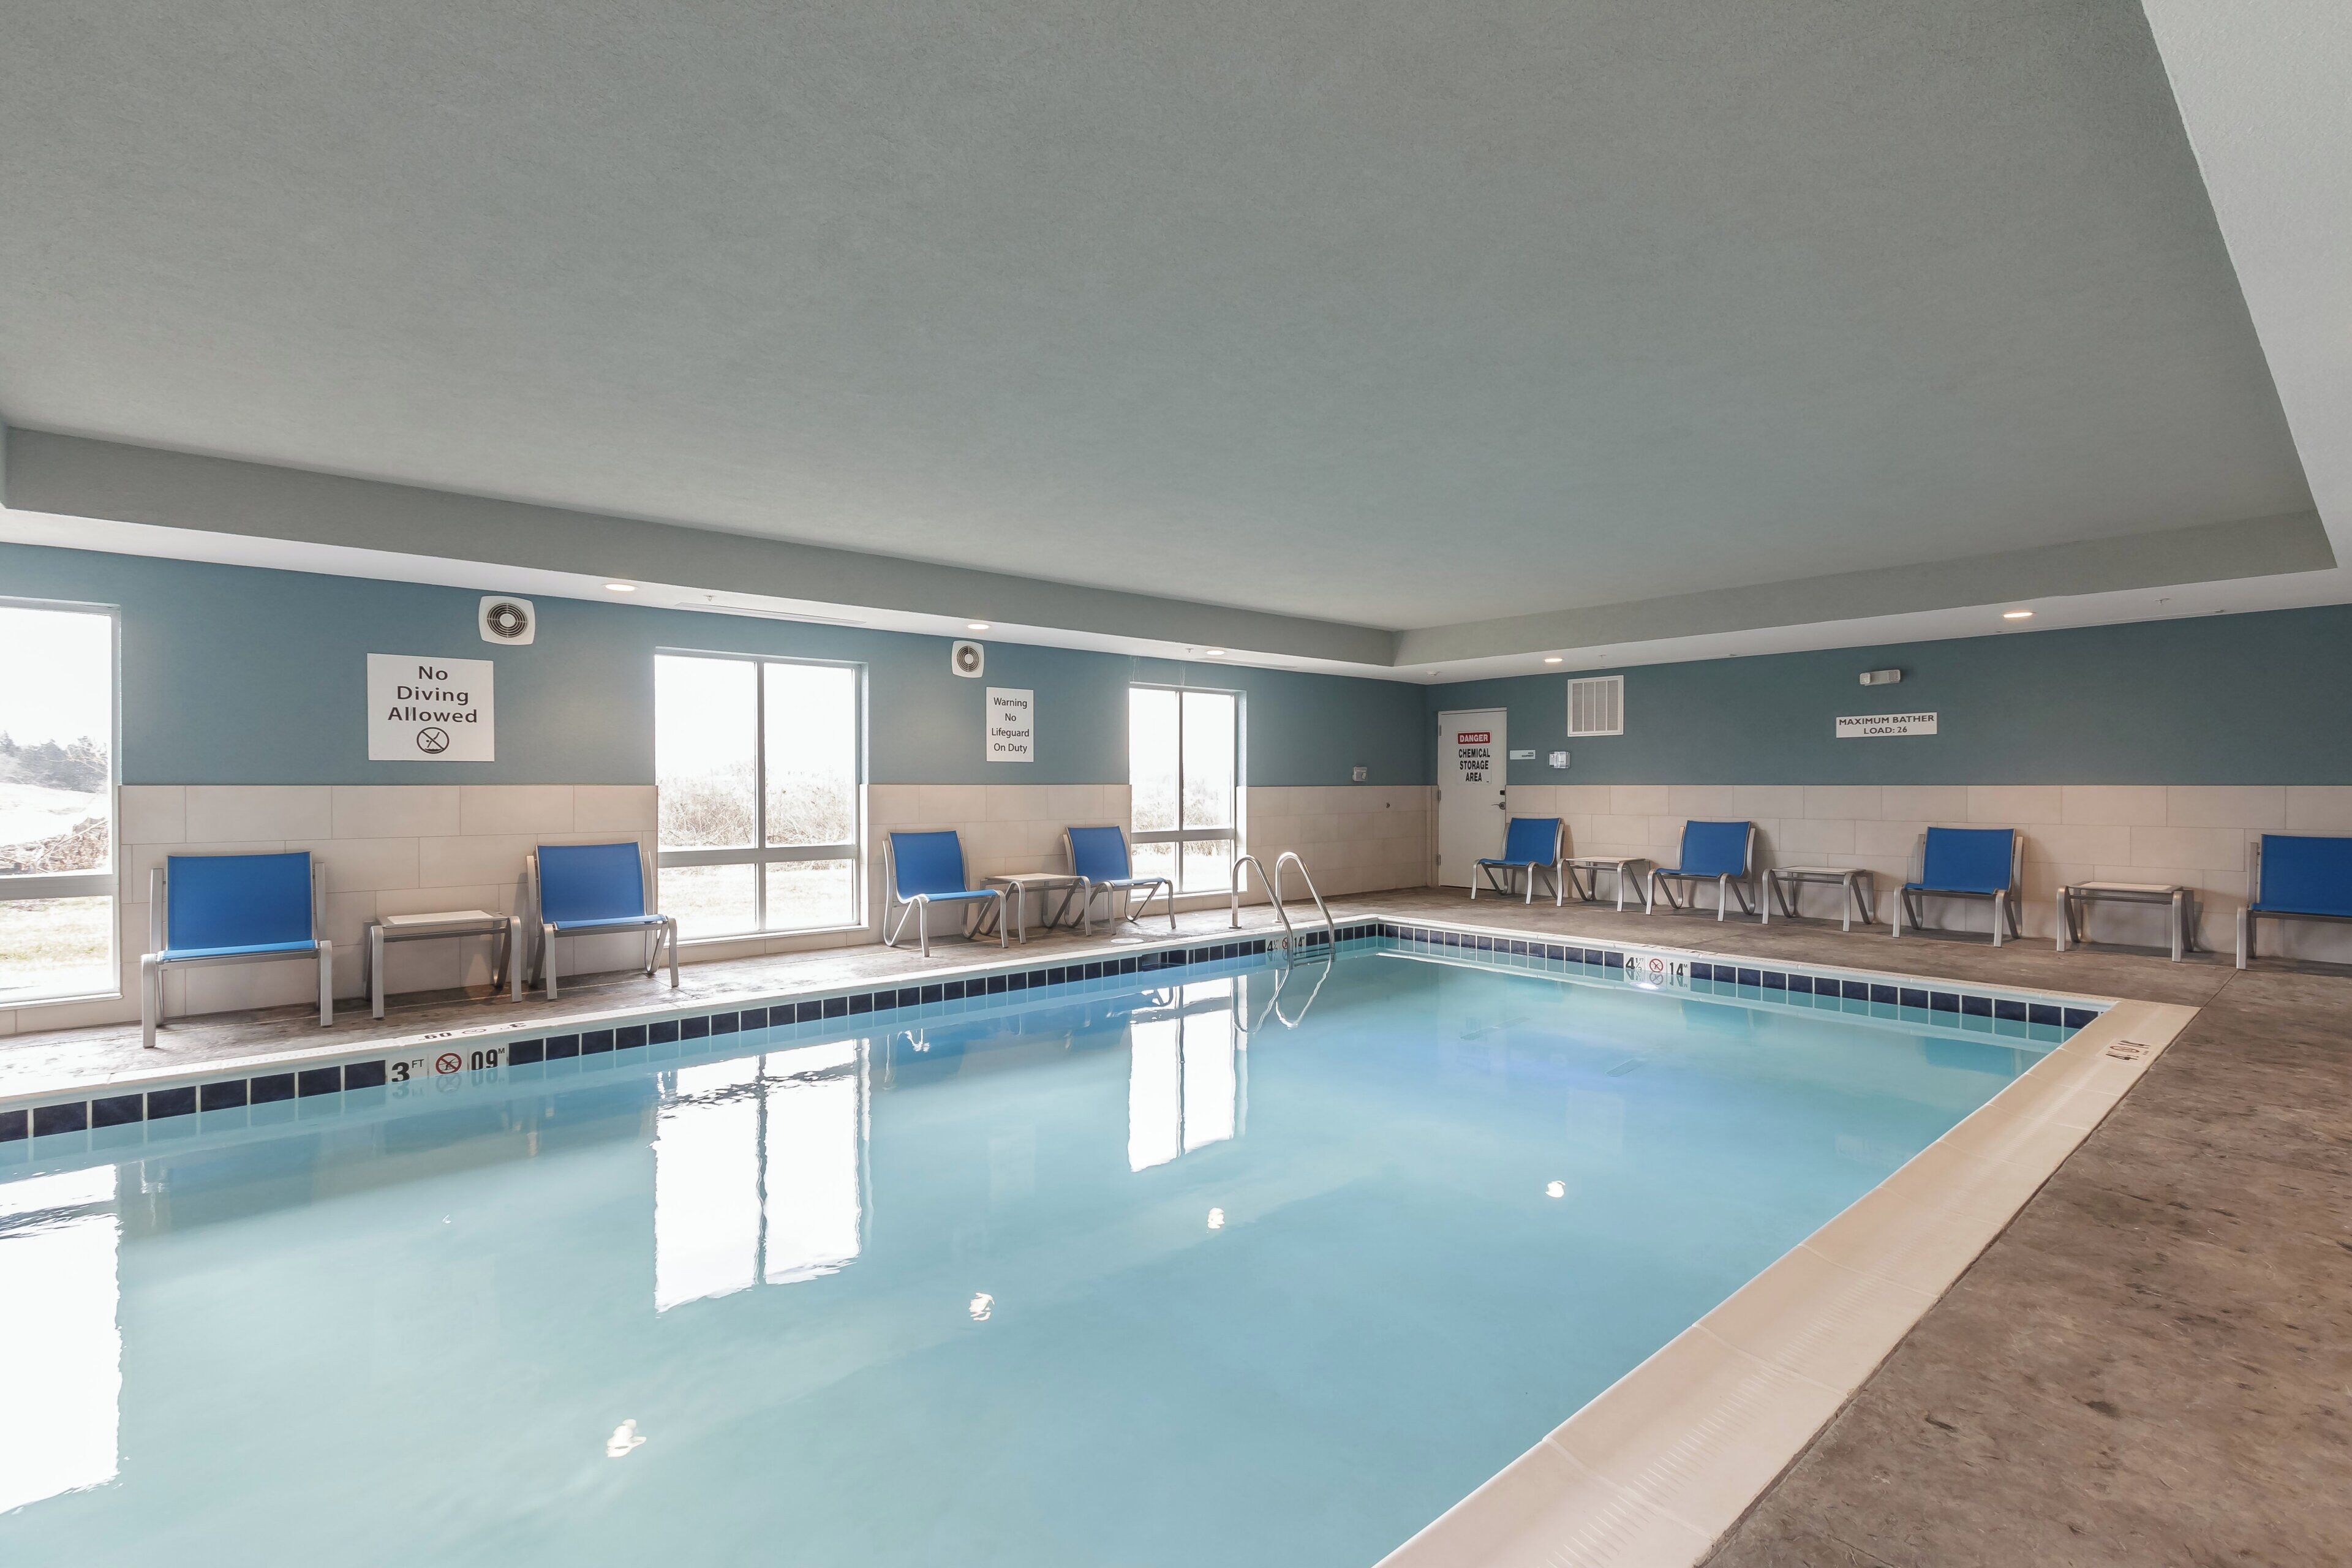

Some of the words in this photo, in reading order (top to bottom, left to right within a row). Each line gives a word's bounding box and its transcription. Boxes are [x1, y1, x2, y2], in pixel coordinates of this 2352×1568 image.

[419, 666, 448, 680] No
[398, 685, 469, 706] Diving
[993, 697, 1027, 709] Warning
[388, 706, 477, 723] Allowed
[1005, 713, 1017, 722] No
[1839, 717, 1890, 726] MAXIMUM
[1892, 715, 1934, 723] BATHER
[992, 727, 1030, 739] Lifeguard
[1460, 734, 1488, 742] DANGER
[993, 743, 1006, 752] On
[1008, 743, 1028, 754] Duty
[1458, 748, 1490, 758] CHEMICAL
[1459, 760, 1489, 770] STORAGE
[1465, 772, 1482, 782] AREA
